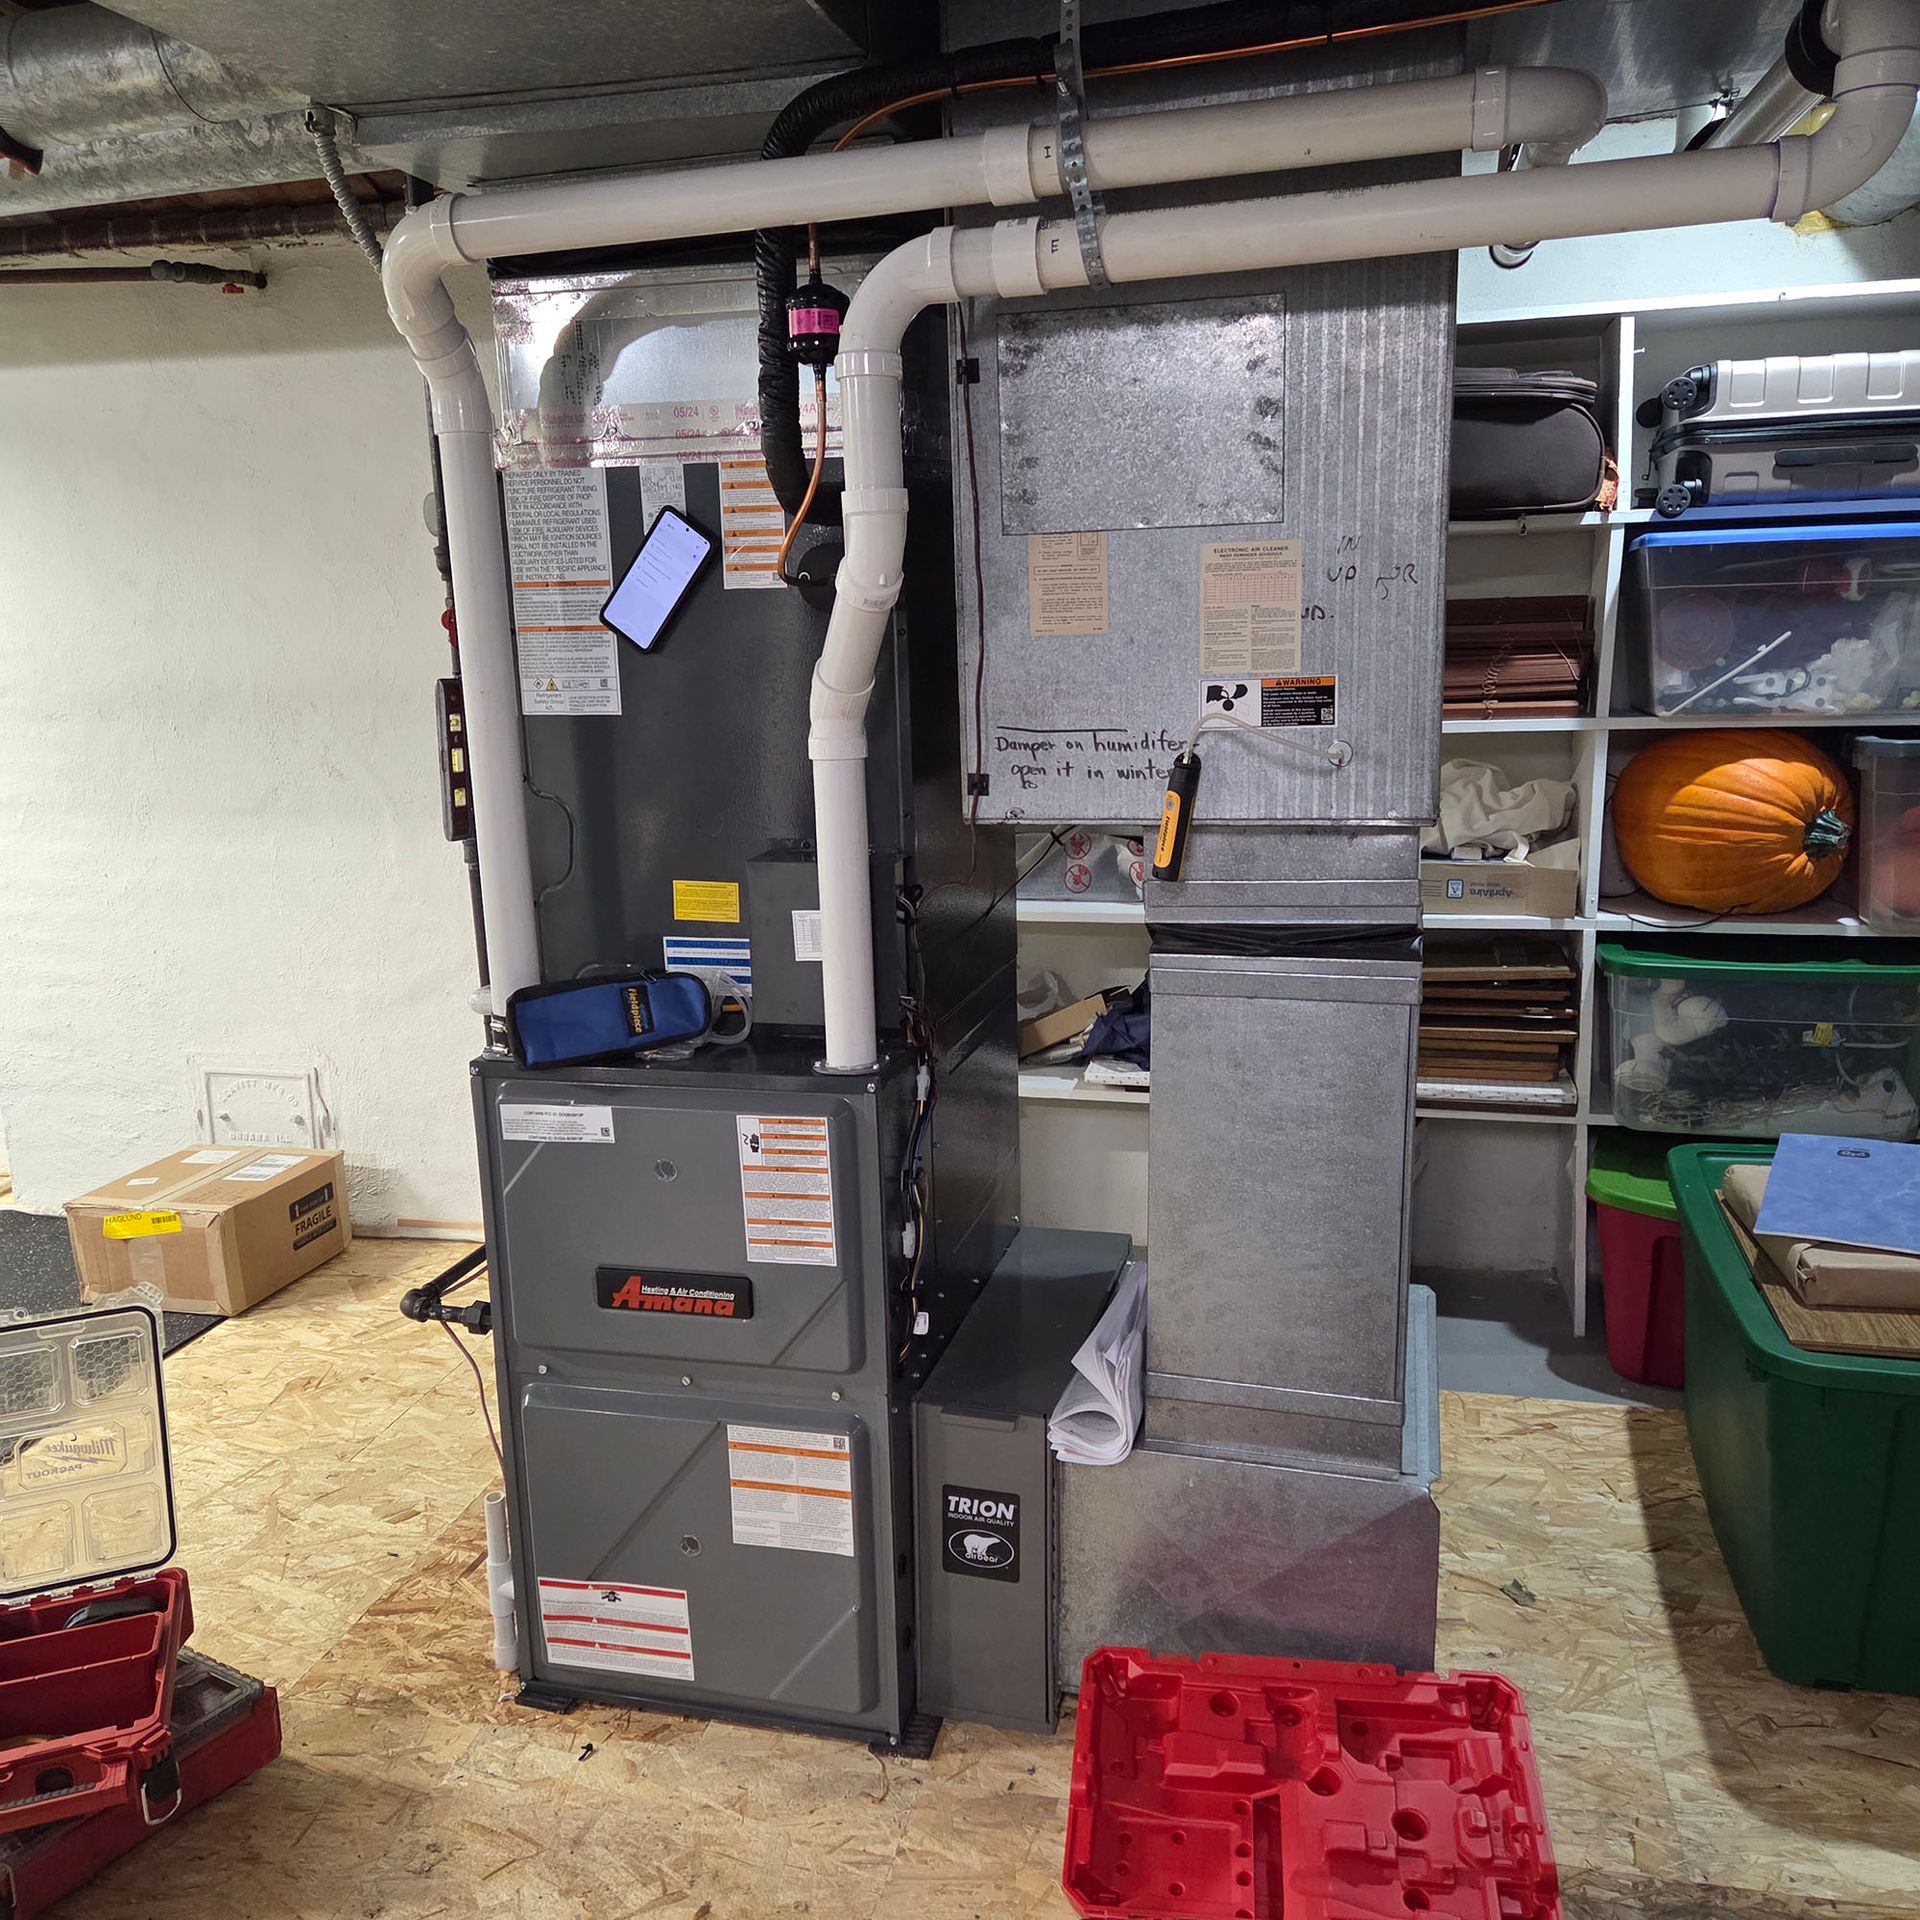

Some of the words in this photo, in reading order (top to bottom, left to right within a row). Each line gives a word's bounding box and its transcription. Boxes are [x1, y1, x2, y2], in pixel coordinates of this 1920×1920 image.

[1043, 145, 1051, 159] I
[1051, 239, 1060, 254] E
[674, 405, 699, 418] 05/24
[801, 403, 816, 414] 4A
[675, 429, 700, 440] 05/24
[530, 502, 567, 510] ACCORDANCE
[550, 541, 579, 549] INSTALLED
[1327, 564, 1356, 587] UP
[1280, 678, 1321, 686] WARNING
[994, 736, 1055, 761] Damper
[1066, 740, 1084, 751] on
[1011, 764, 1047, 789] open
[1056, 761, 1075, 777] it
[1087, 765, 1104, 779] in
[1161, 815, 1171, 852] Fieldpiece
[627, 988, 643, 1033] Fieldpiece
[105, 1212, 142, 1225] HAGLUND
[294, 1205, 332, 1236] FRAGILE
[611, 1275, 735, 1316] Amana
[641, 1284, 668, 1295] Heating
[669, 1286, 676, 1295] &
[677, 1287, 689, 1296] Air
[689, 1288, 735, 1300] Conditioning
[948, 1495, 1015, 1520] TRION
[947, 1512, 973, 1520] INDOOR
[986, 1518, 1015, 1527] QUALITY
